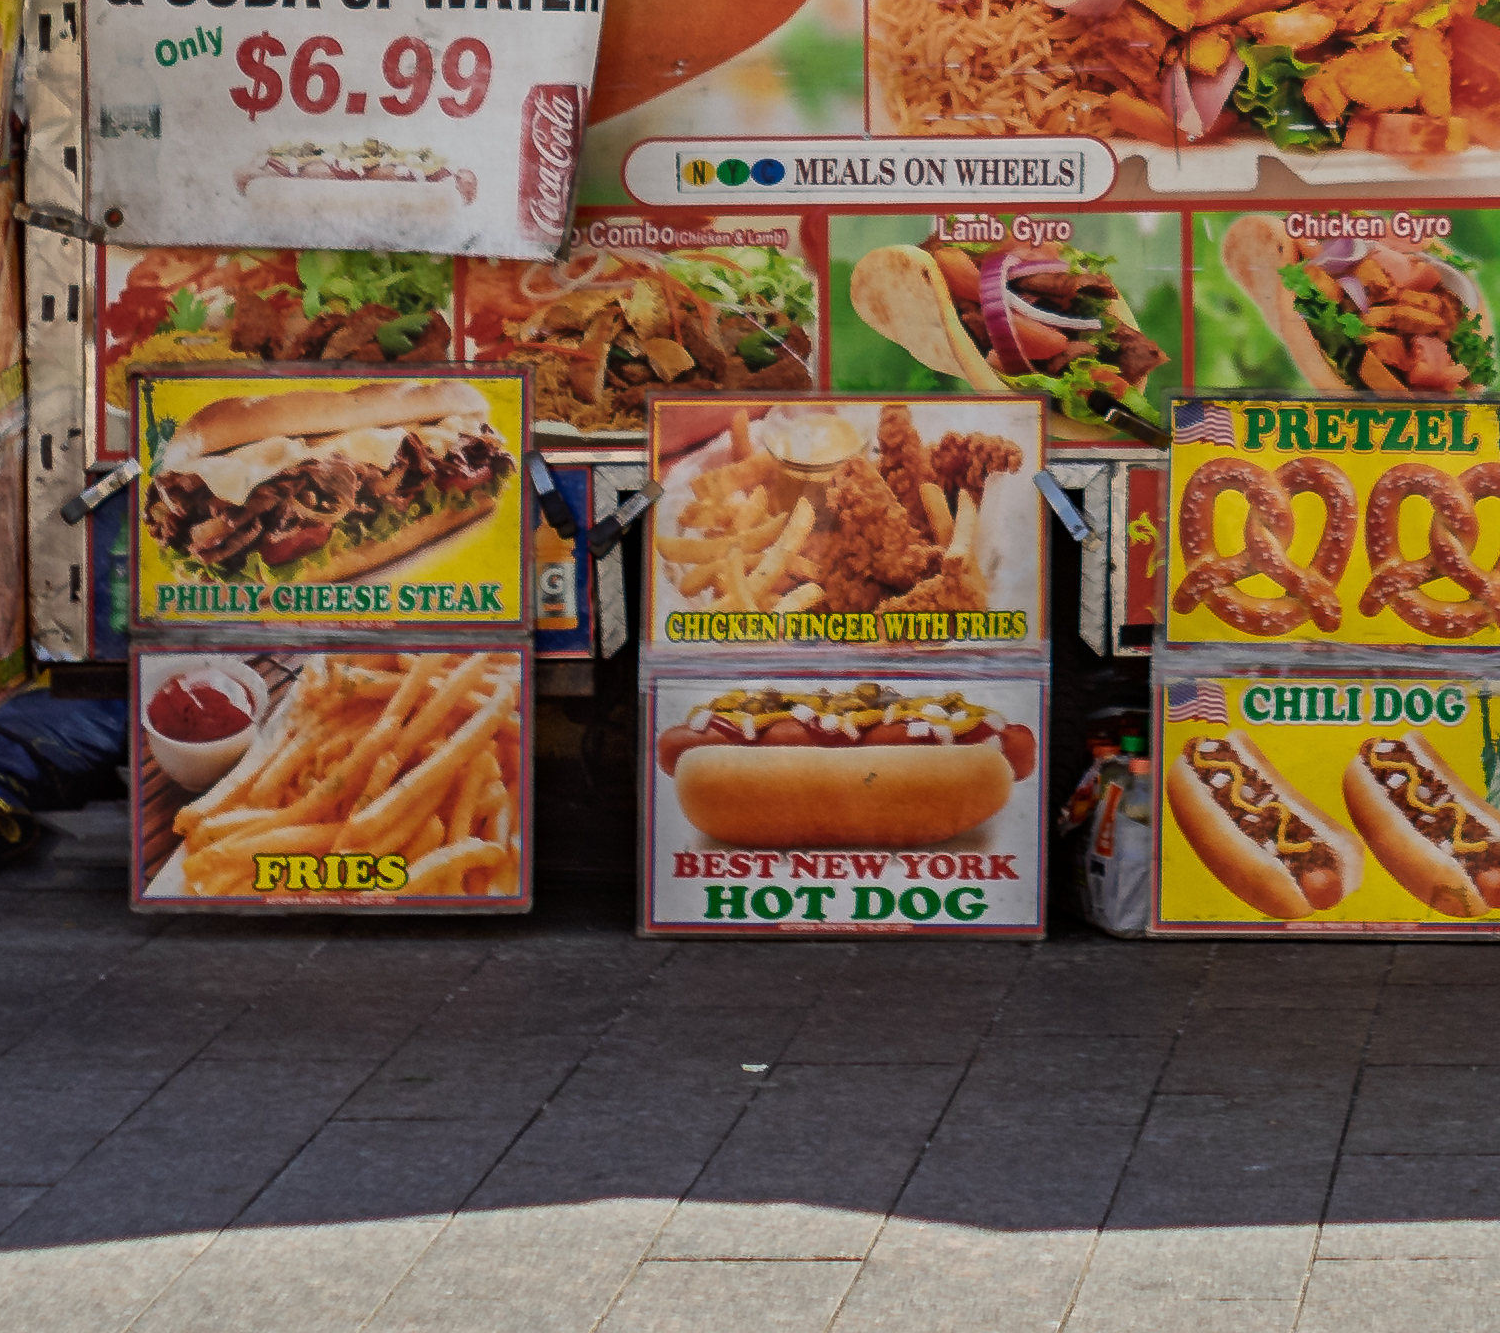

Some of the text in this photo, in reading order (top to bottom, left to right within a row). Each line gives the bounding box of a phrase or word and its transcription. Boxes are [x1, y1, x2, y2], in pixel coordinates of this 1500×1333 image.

[153, 24, 224, 68] Only
[228, 30, 493, 122] $6.99
[794, 158, 896, 186] MEALS
[904, 158, 947, 186] ON
[954, 157, 1076, 187] WHEELS
[588, 221, 675, 247] Combo
[674, 230, 731, 248] (Chicken
[748, 229, 788, 248] Lamb)
[937, 215, 1072, 245] Lamb Gyro
[1285, 212, 1452, 241] Chicken Gyro
[1242, 407, 1482, 453] PRETZEL
[156, 582, 504, 615] PHILLY CHEESE STEAK
[665, 610, 1028, 643] CHICKEN FINGER WITH FRIES
[1242, 685, 1468, 723] CHILI DOG
[252, 852, 410, 893] FRIES
[672, 851, 1020, 881] BEST NEW YORK
[703, 884, 990, 921] HOT DOG
